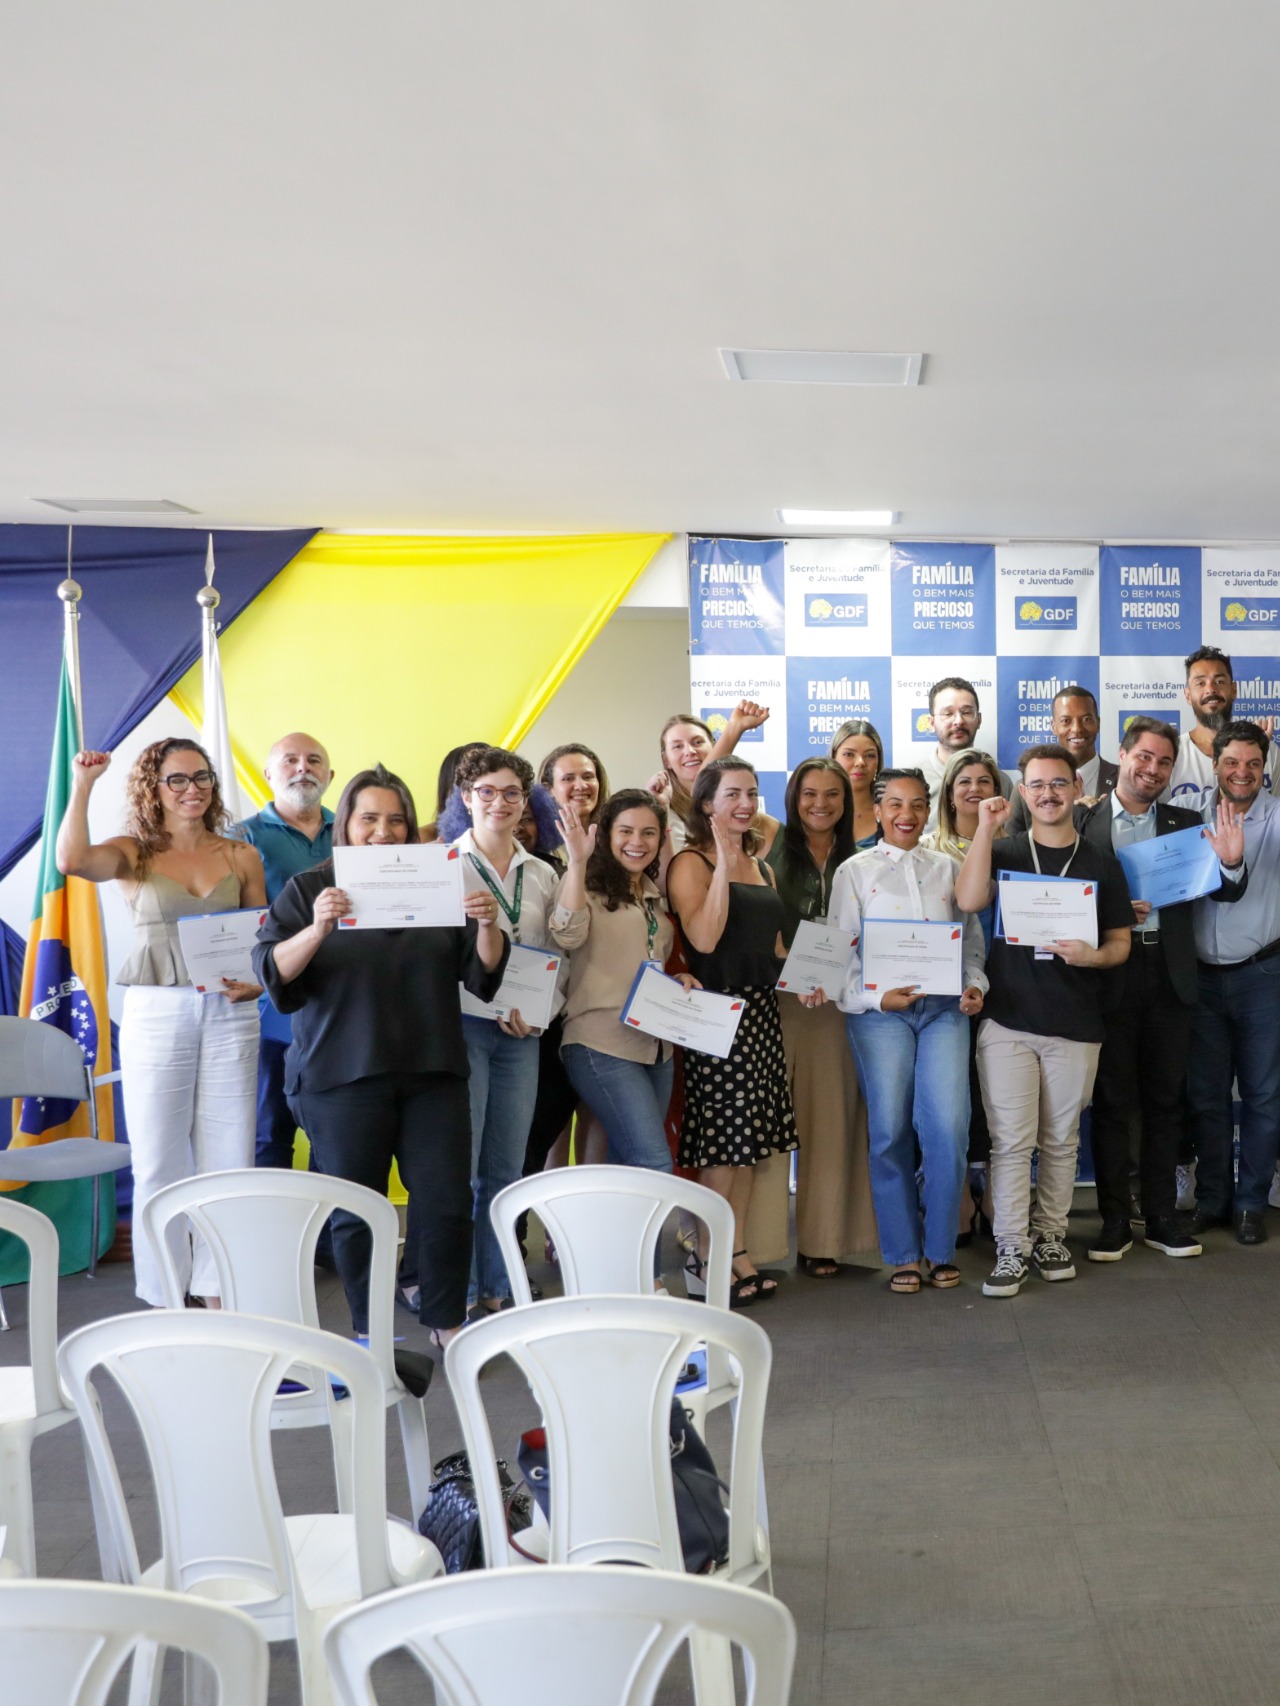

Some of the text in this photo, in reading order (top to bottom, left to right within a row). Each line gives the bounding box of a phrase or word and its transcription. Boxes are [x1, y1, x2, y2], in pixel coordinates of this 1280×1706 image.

[700, 561, 762, 584] FAMÍLIA
[853, 564, 885, 572] amíli
[912, 562, 974, 585] FAMÍLIA
[1063, 568, 1094, 576] Família
[1120, 563, 1180, 586] FAMÍLIA
[834, 605, 864, 618] GDF
[914, 601, 973, 617] PRECIOSO
[1044, 609, 1074, 620] GDF
[1122, 603, 1180, 618] PRECIOSO
[1248, 610, 1278, 621] GDF
[702, 620, 763, 629] QUE TEMOS
[913, 621, 974, 630] QUE TEMOS
[1121, 622, 1143, 630] QUE
[749, 679, 781, 687] Família
[808, 677, 870, 700] FAMÍLIA
[1018, 676, 1078, 699] FAMÍ
[1020, 716, 1053, 732] PREC
[809, 736, 831, 745] QUE
[1019, 736, 1040, 744] QUE
